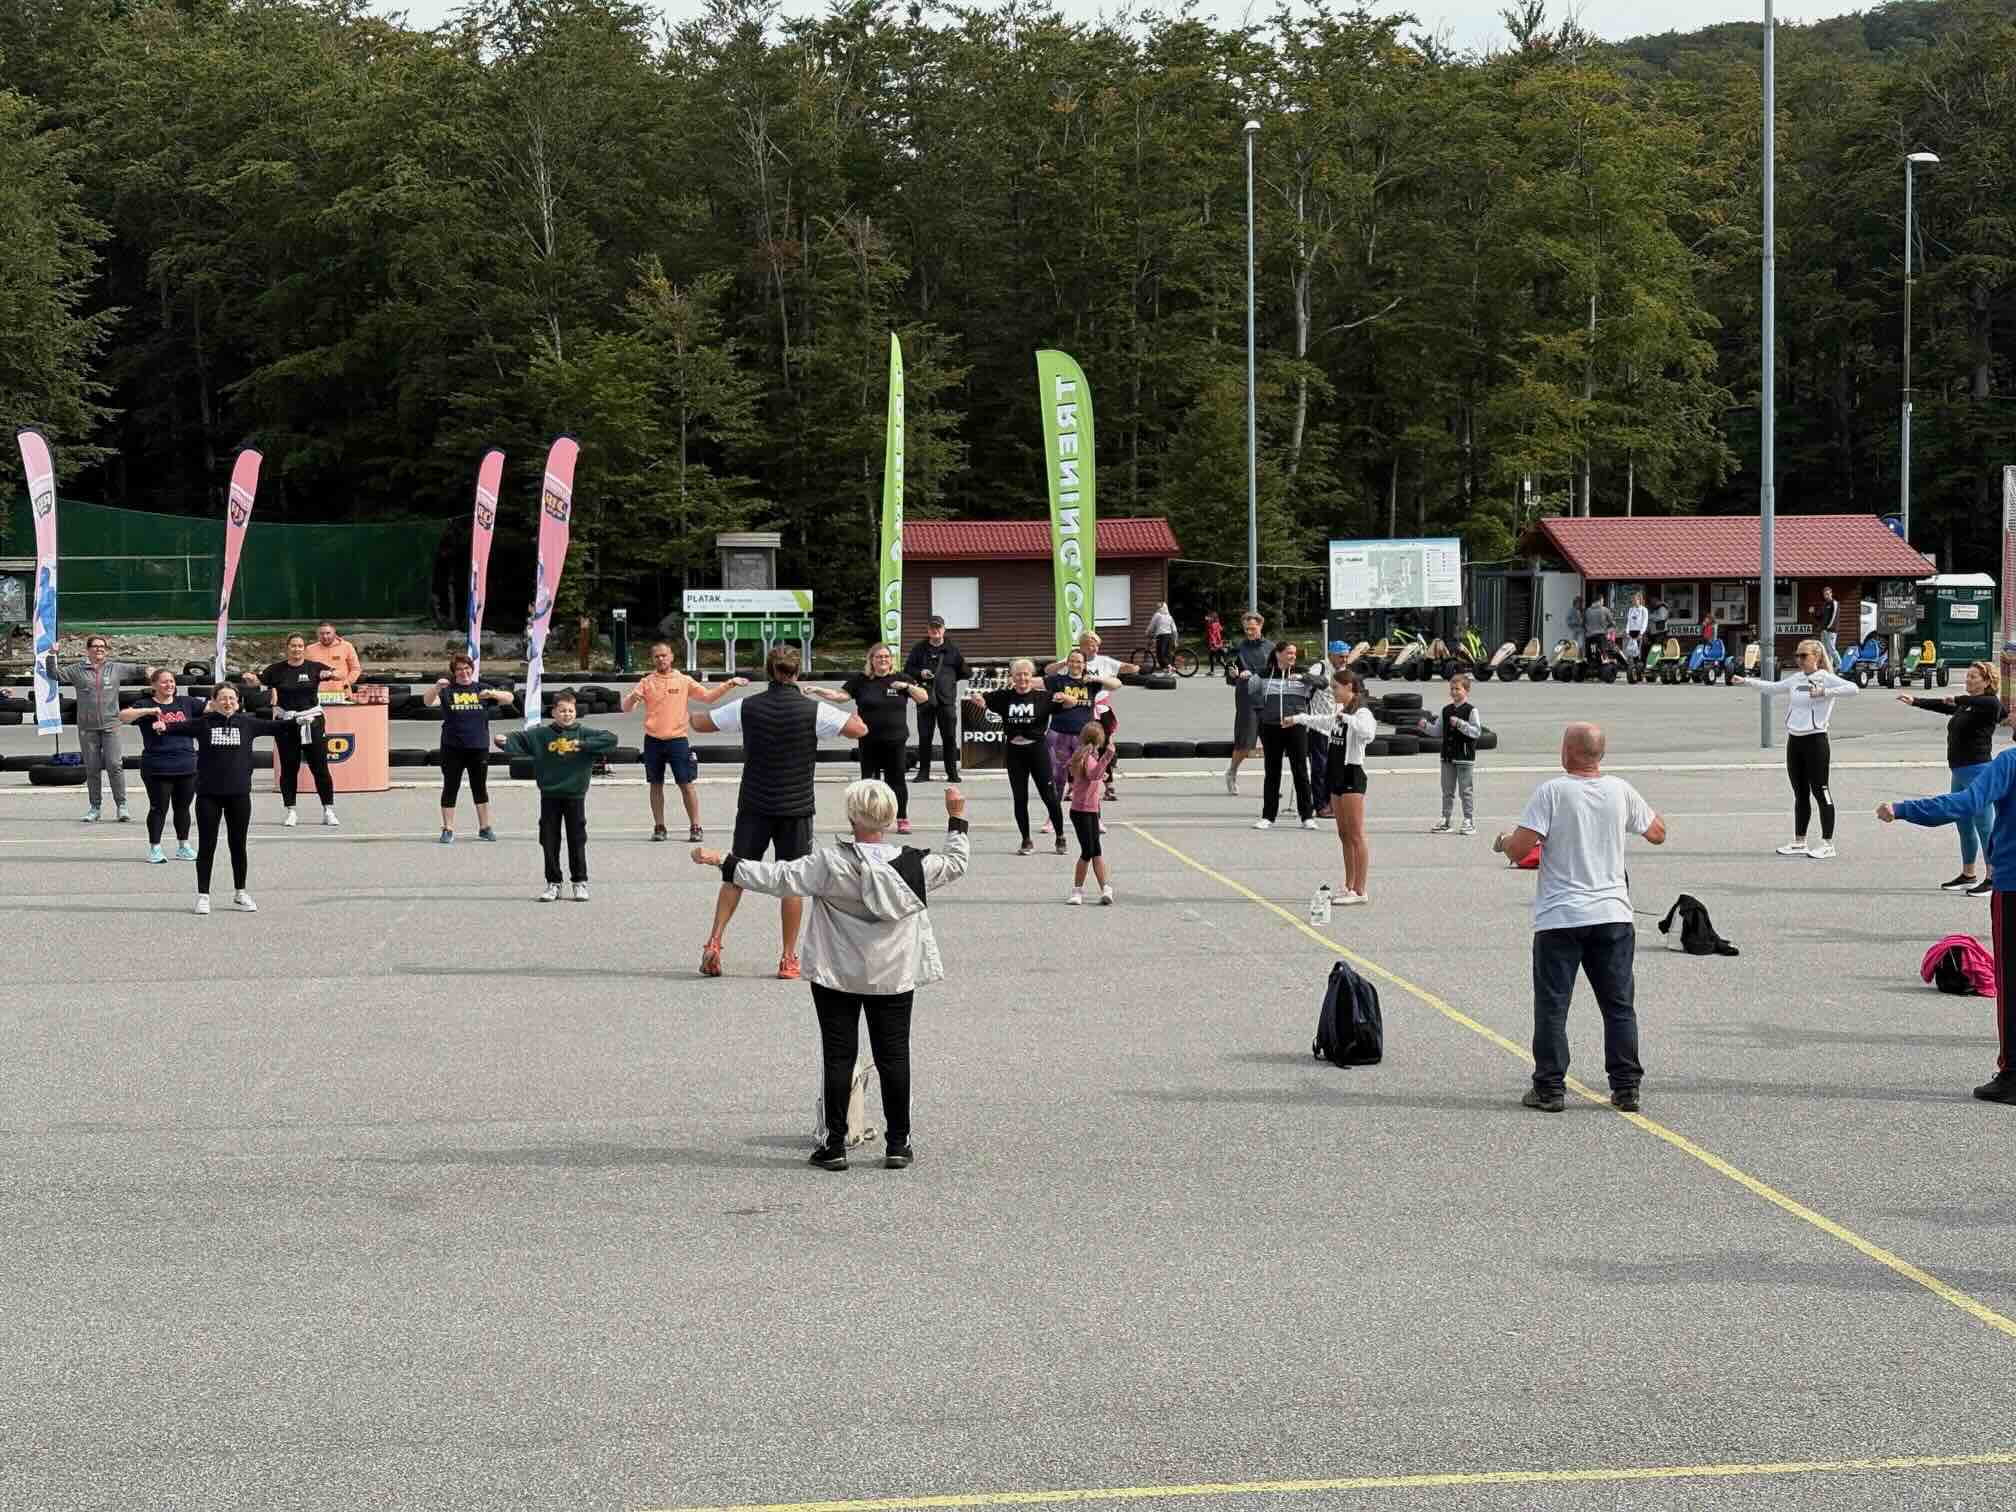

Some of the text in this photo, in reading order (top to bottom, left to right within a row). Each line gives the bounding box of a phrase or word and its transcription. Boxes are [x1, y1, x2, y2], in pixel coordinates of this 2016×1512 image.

[687, 594, 721, 603] PLATAK
[1009, 703, 1034, 717] MM
[963, 731, 1007, 744] PROT
